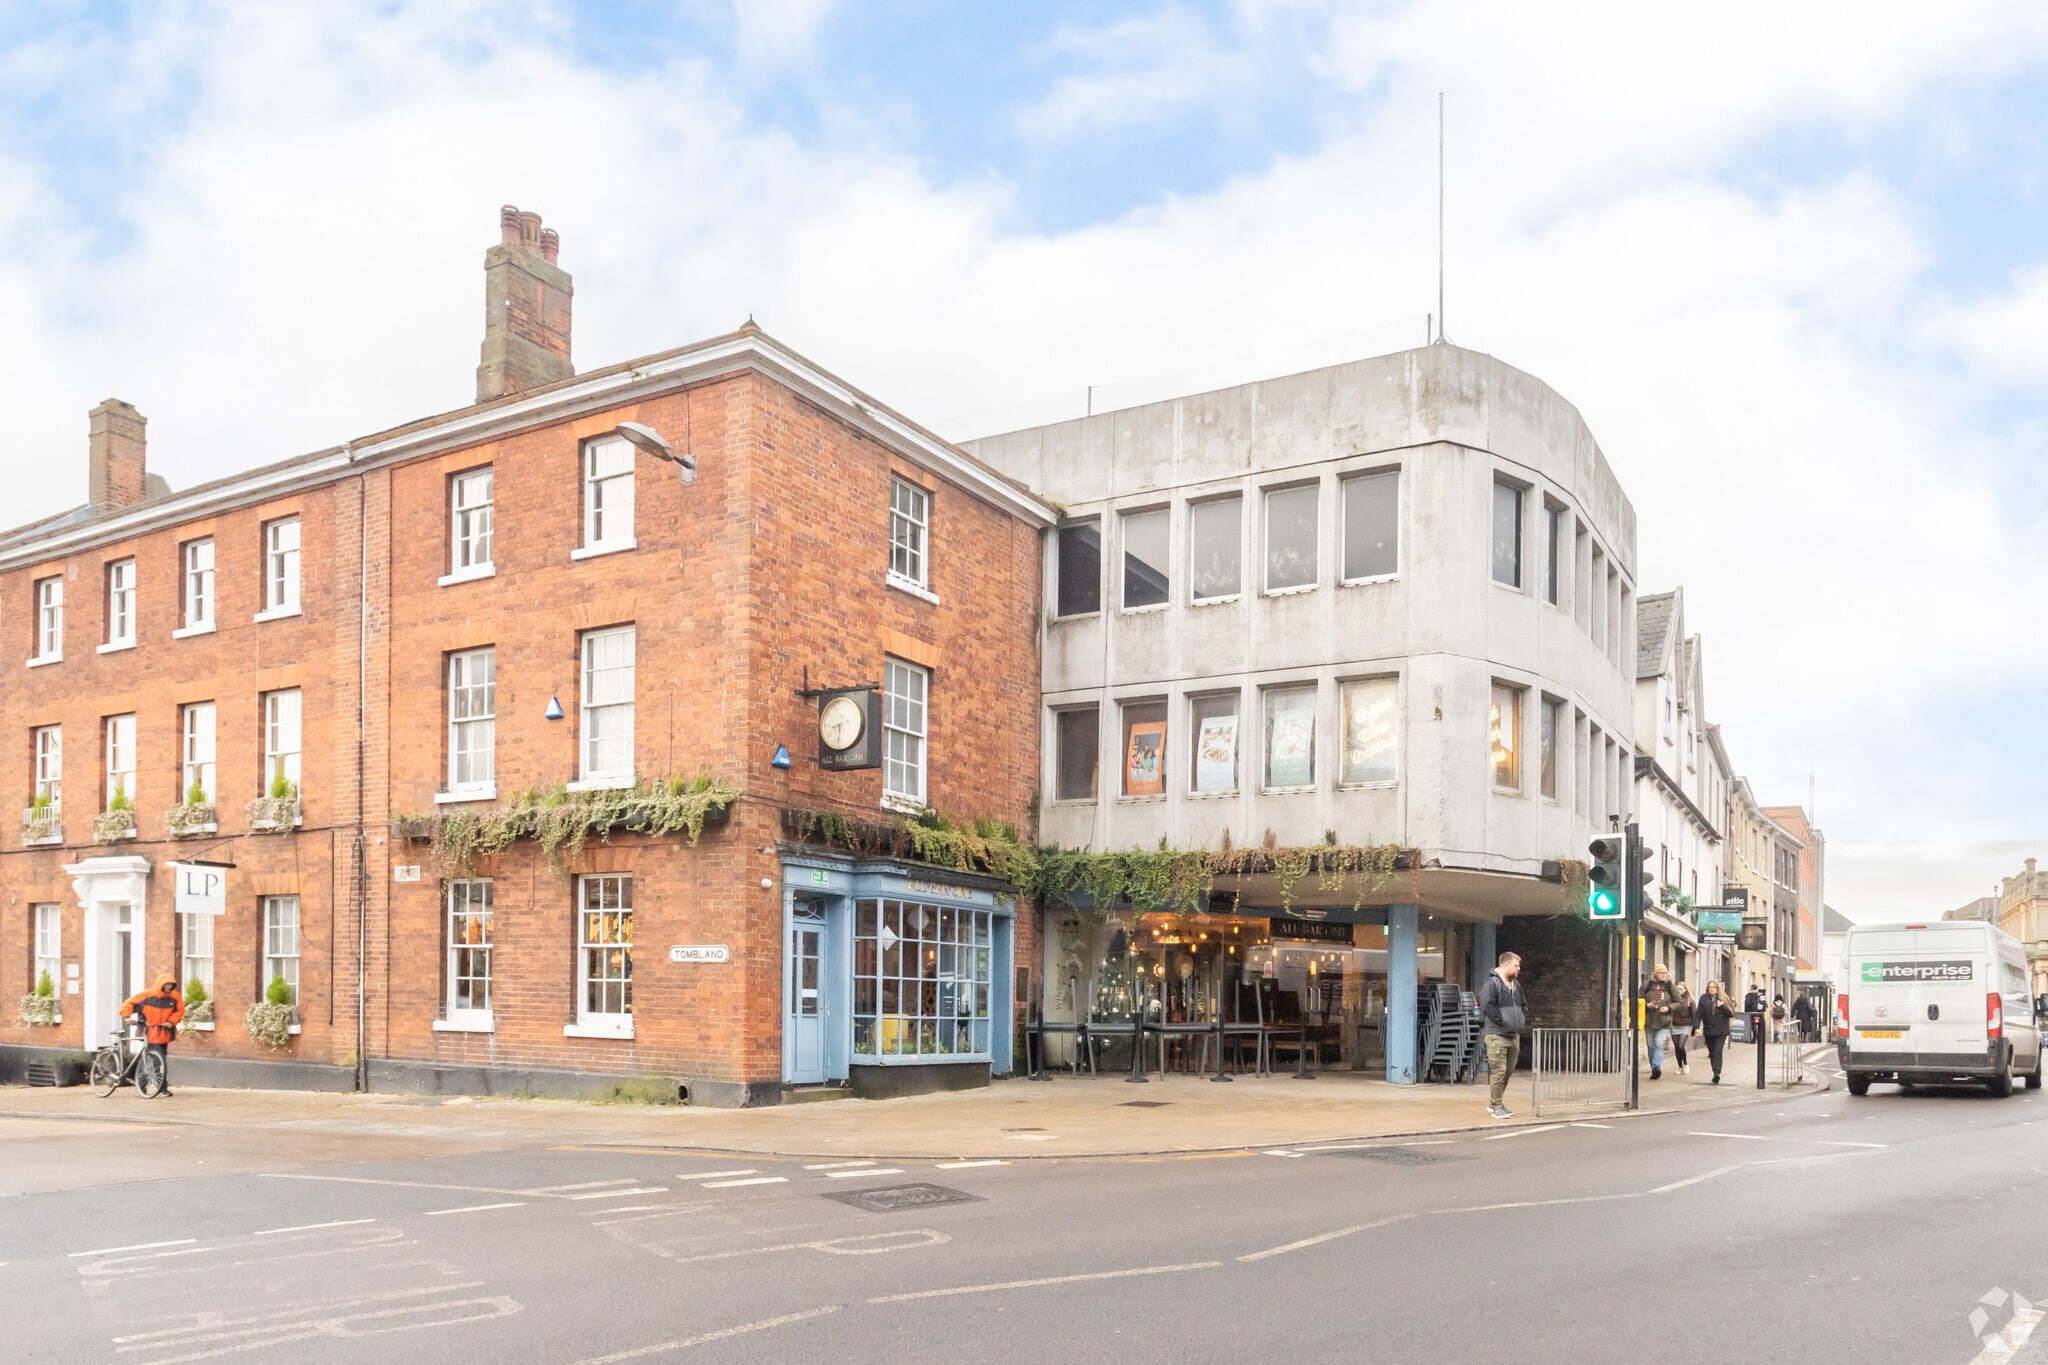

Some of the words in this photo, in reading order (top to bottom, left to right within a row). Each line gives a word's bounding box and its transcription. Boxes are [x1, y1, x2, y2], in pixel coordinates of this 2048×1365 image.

[1354, 699, 1393, 723] Coffee
[1357, 720, 1390, 743] Wine
[822, 755, 833, 764] ALL
[835, 754, 848, 763] BAR
[850, 753, 865, 761] ONE
[185, 871, 219, 897] LP
[907, 879, 926, 893] ALL
[929, 881, 949, 896] BAR
[1726, 896, 1744, 905] attic
[1281, 923, 1297, 934] ALL
[1303, 924, 1322, 935] BAR
[674, 949, 724, 959] TOMBLAND
[1865, 964, 1972, 980] enterprise
